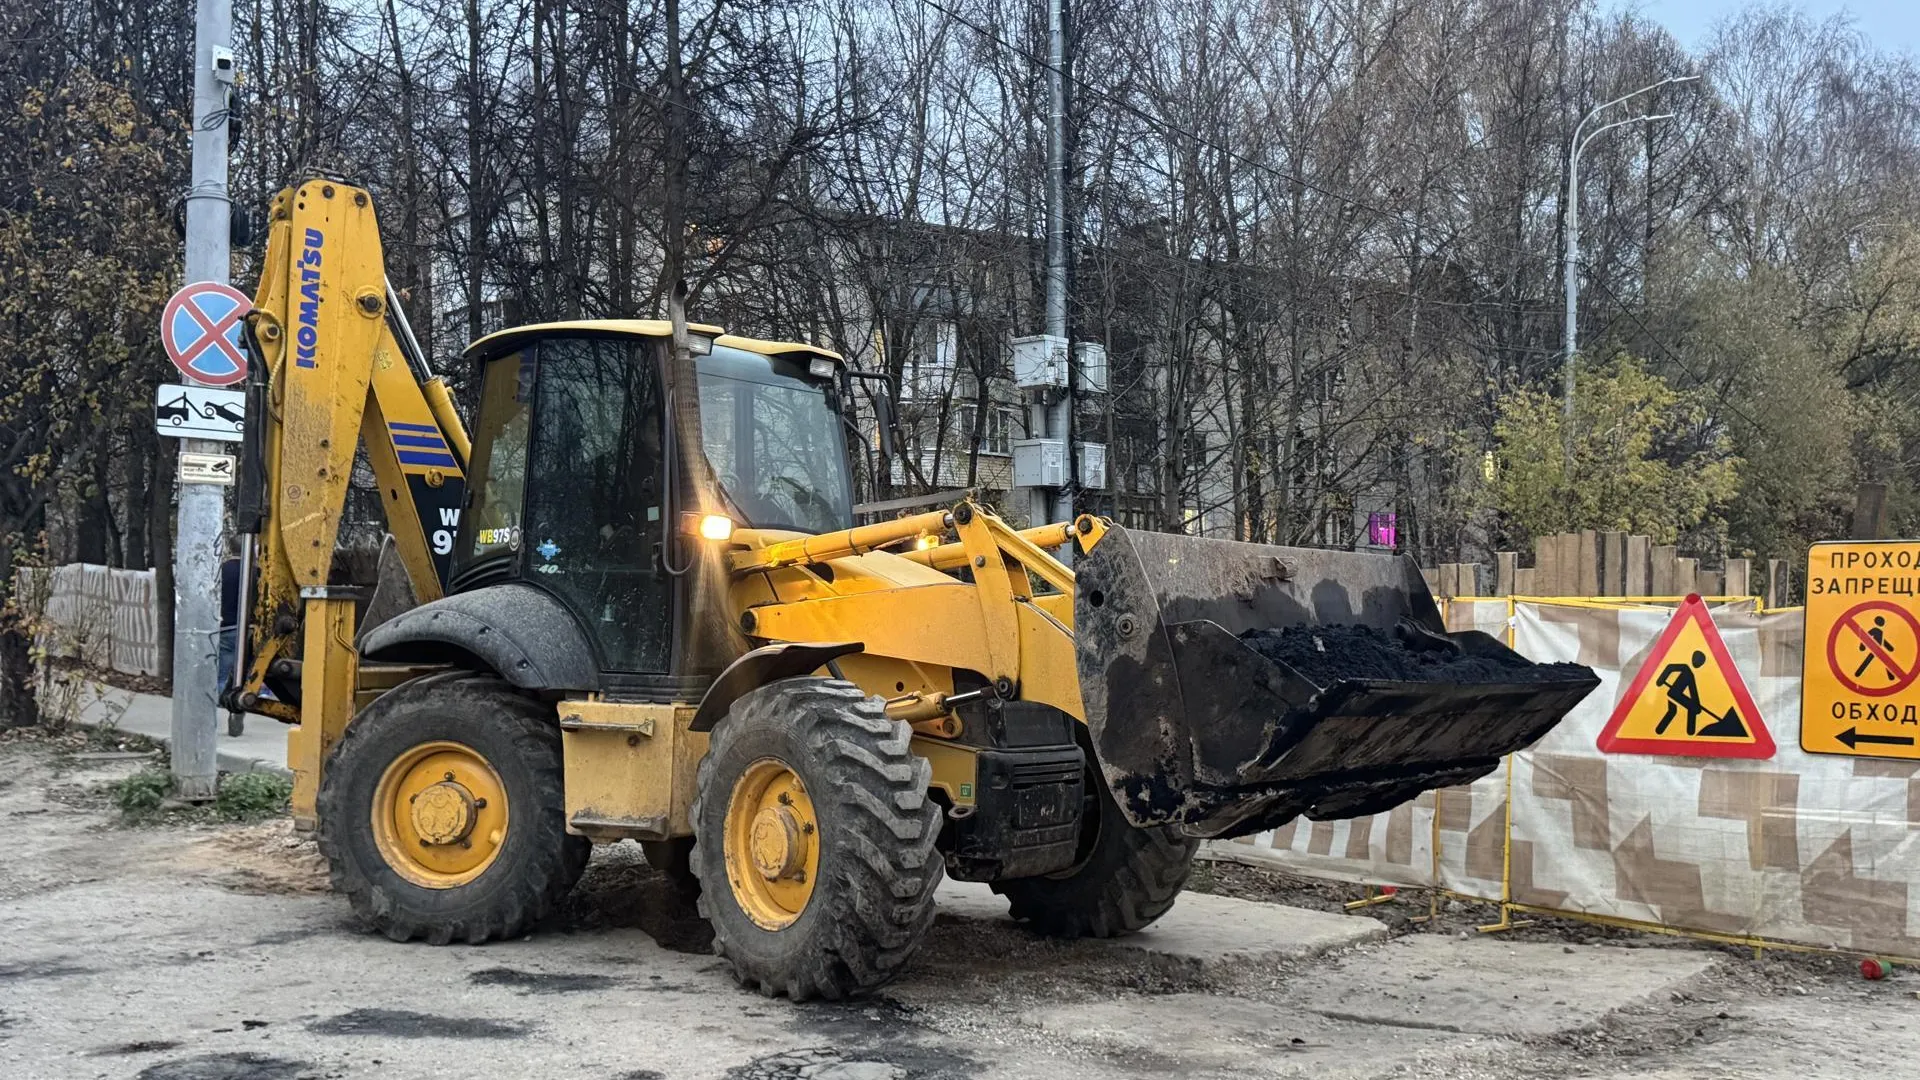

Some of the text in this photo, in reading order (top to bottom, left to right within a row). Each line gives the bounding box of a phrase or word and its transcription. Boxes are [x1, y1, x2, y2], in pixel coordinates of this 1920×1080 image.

[296, 228, 324, 369] KOMATSU
[432, 529, 457, 555] 9
[479, 527, 510, 544] WB97S
[1811, 577, 1920, 597] ЗАПРЕЩ
[1831, 701, 1918, 726] ОБХОД
